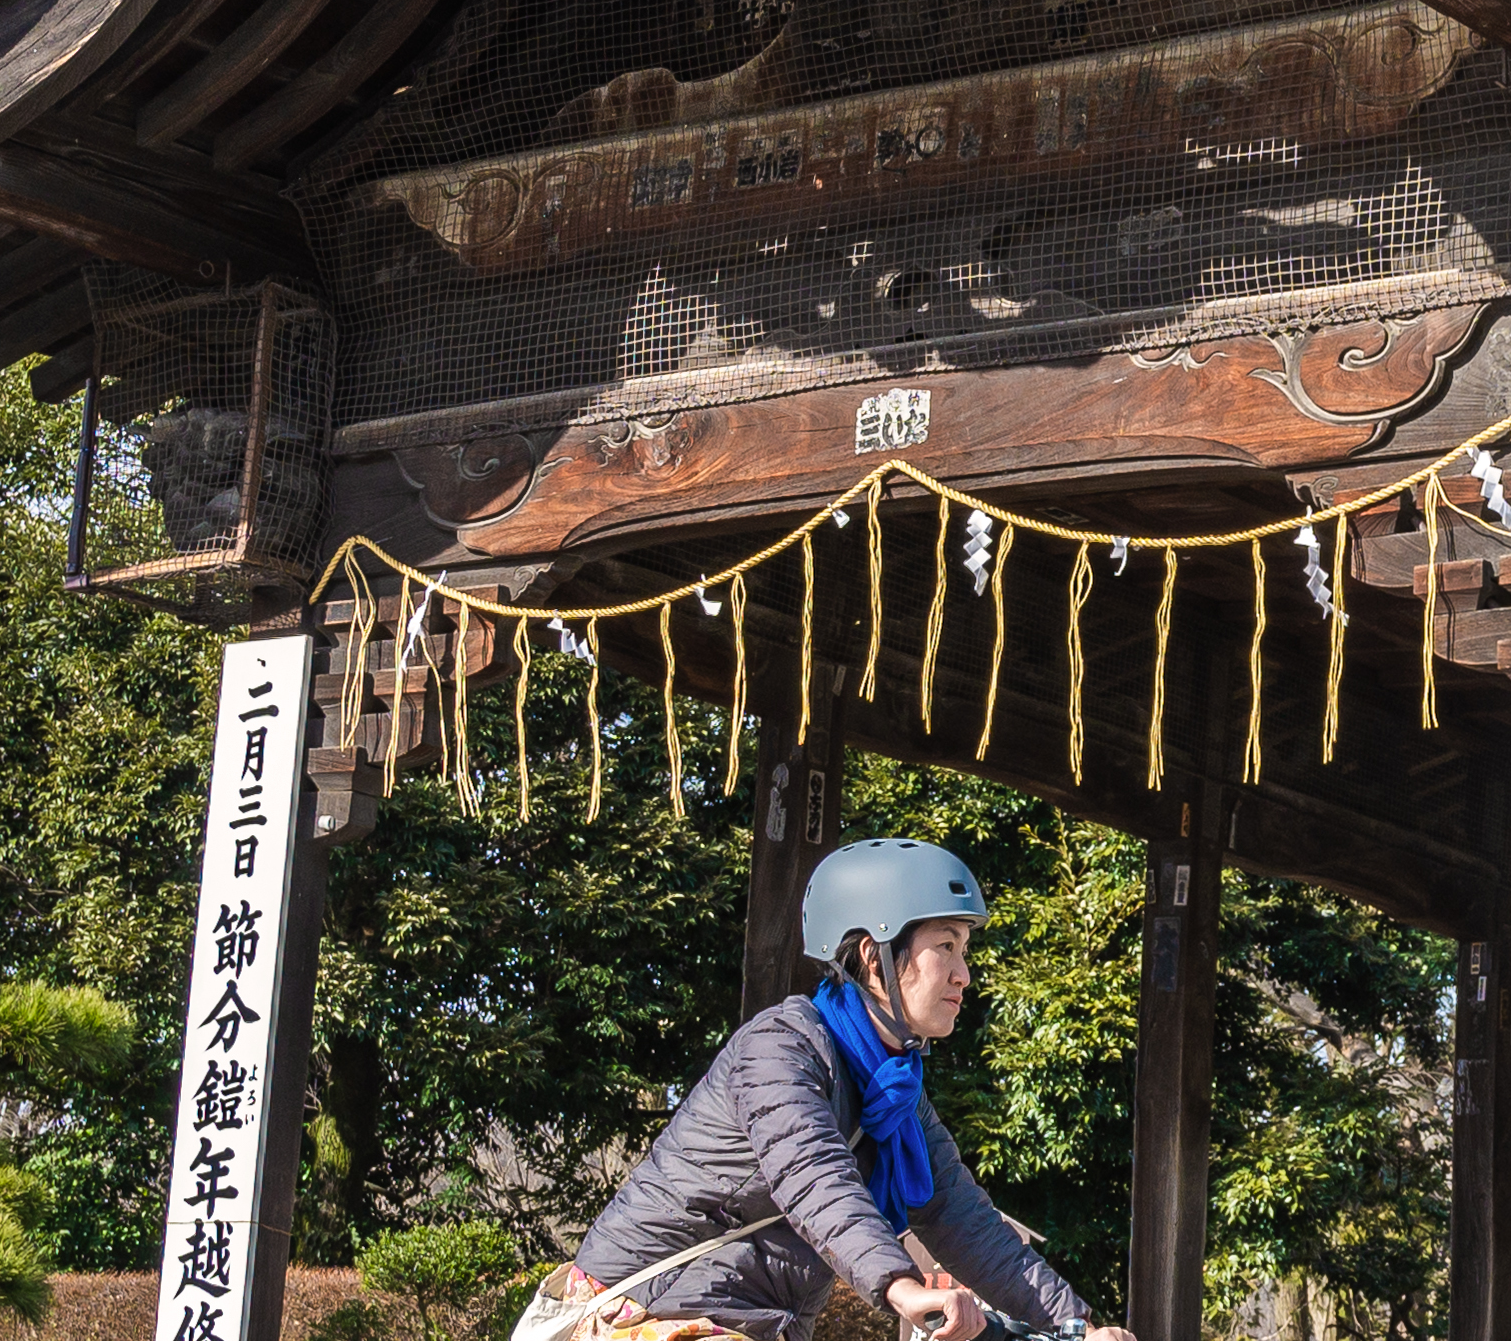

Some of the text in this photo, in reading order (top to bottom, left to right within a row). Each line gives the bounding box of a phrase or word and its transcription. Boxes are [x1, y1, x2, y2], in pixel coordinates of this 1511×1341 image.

[228, 679, 280, 879] 二月三日
[245, 1064, 258, 1125] よろい
